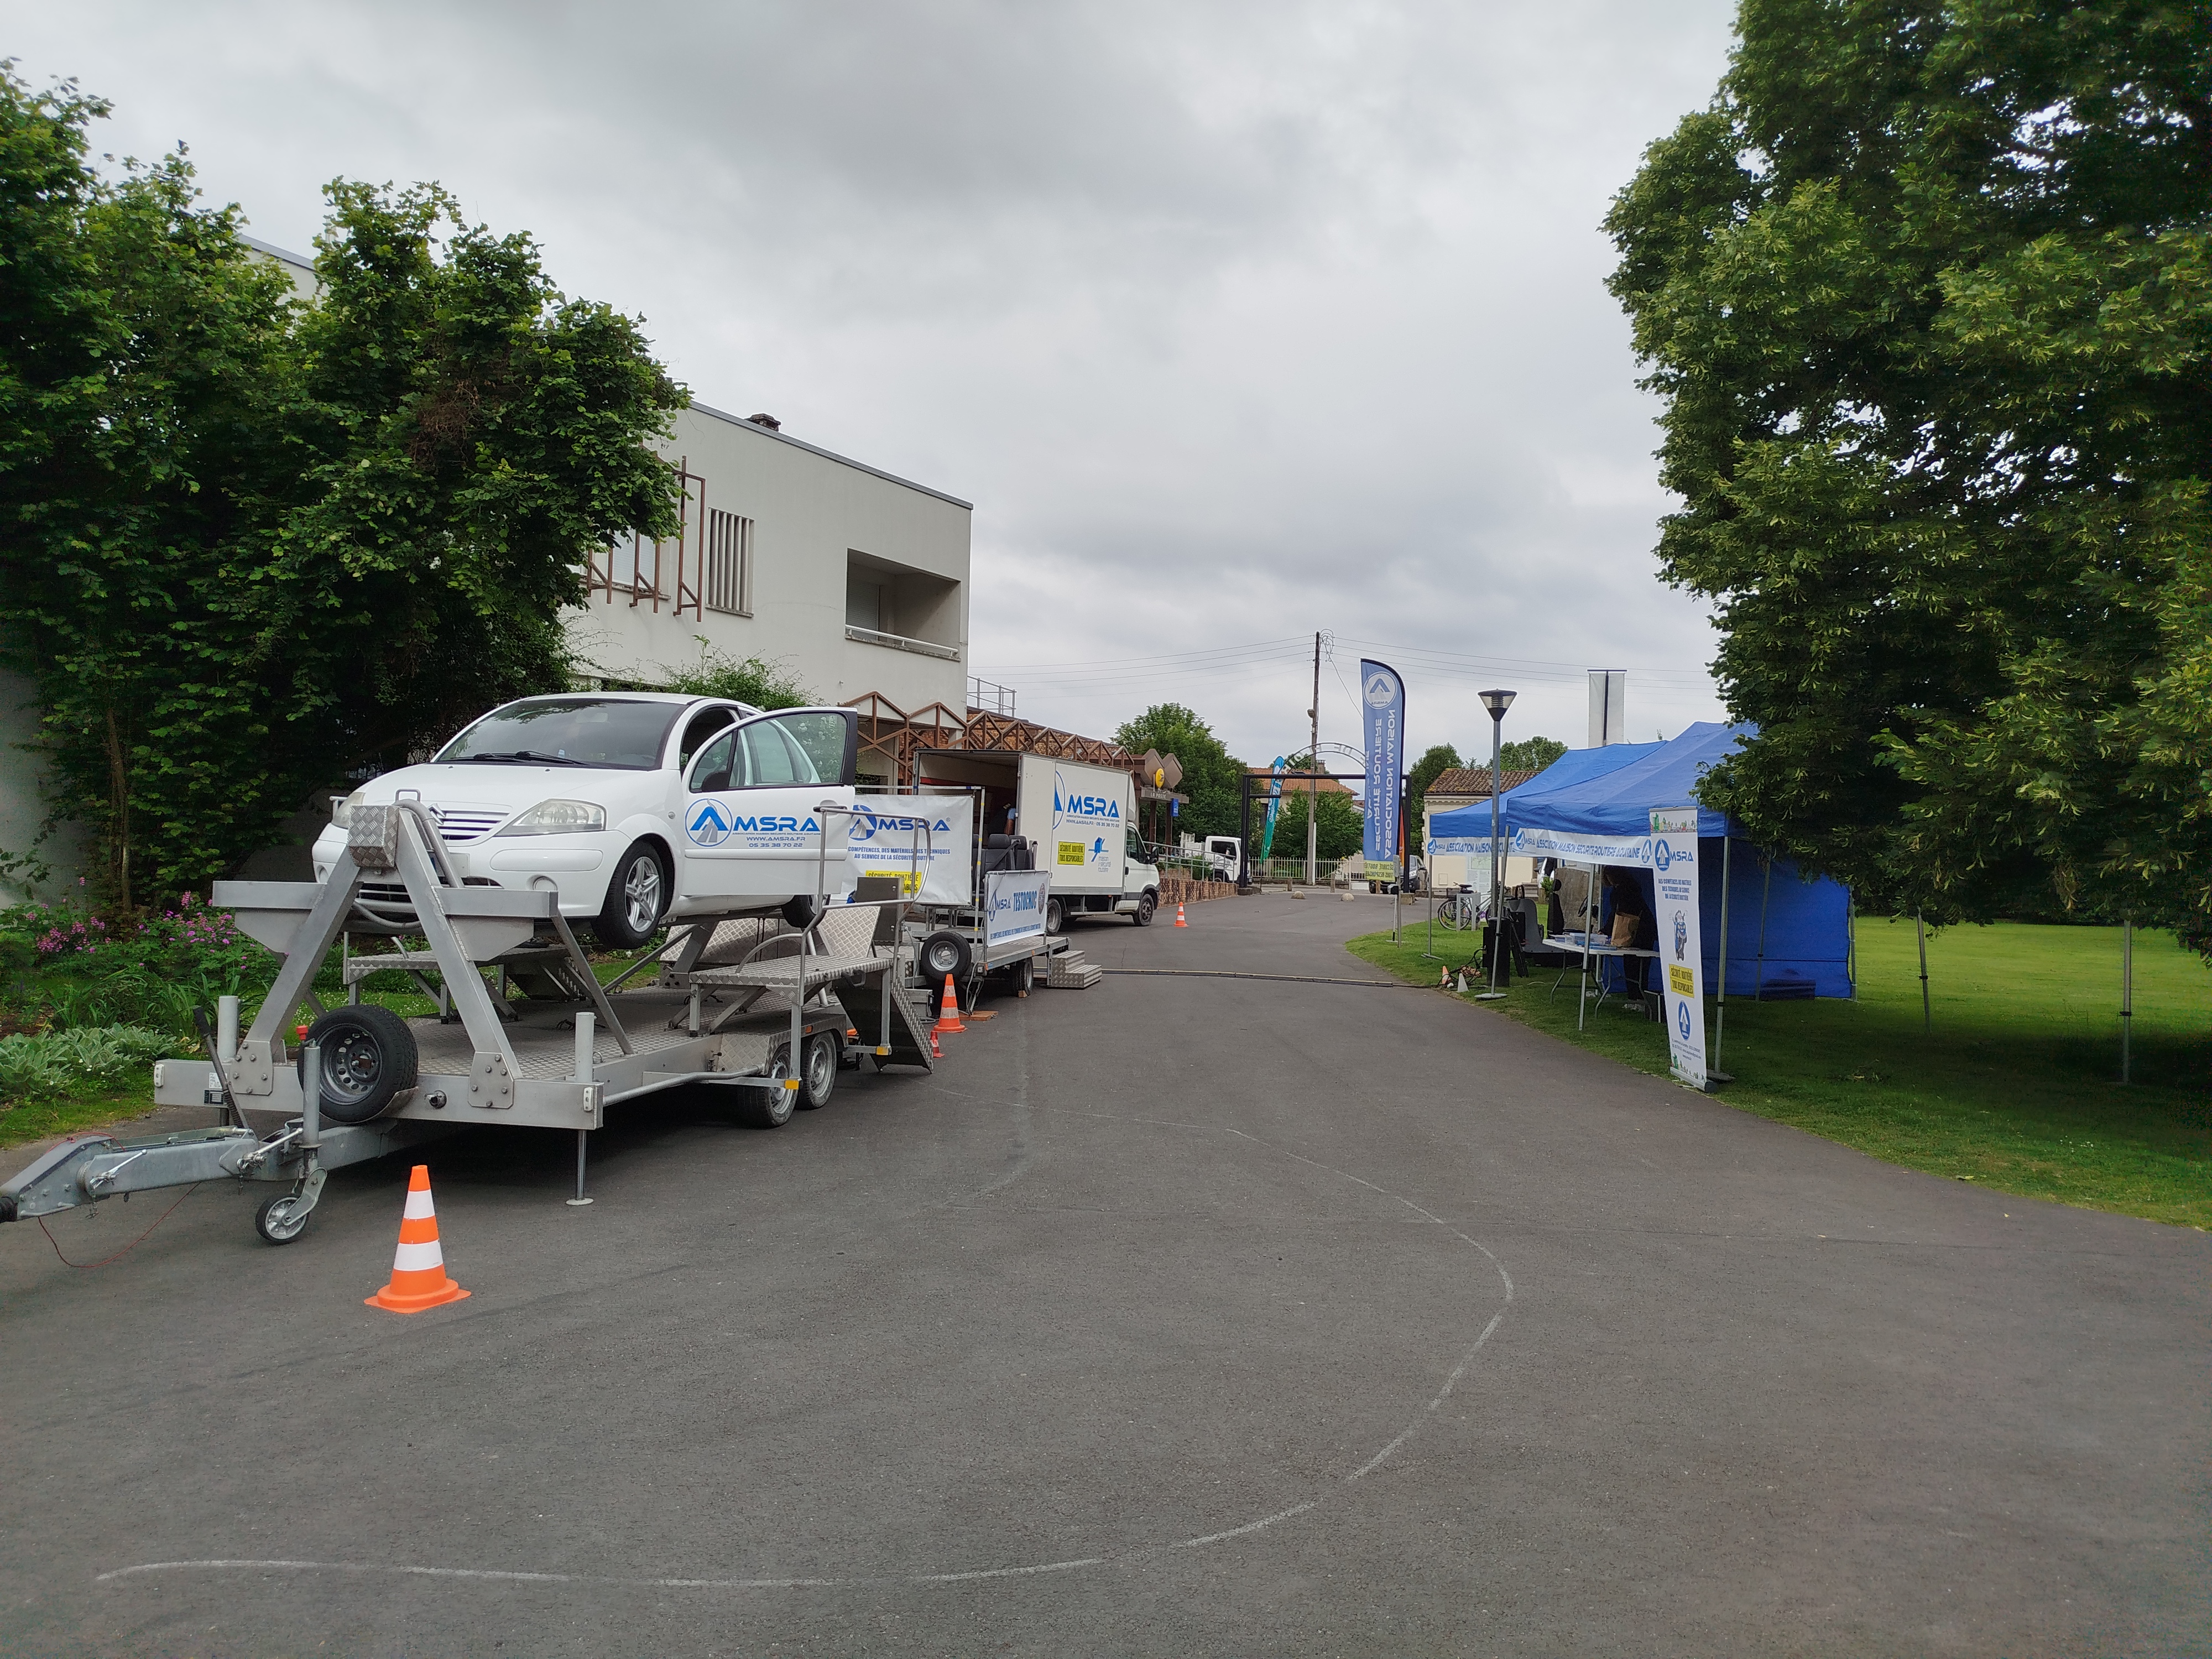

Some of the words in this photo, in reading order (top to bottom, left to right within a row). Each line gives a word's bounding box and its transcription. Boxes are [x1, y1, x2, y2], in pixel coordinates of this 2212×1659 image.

[1446, 842, 1474, 853] ASSCIATION
[1474, 843, 1492, 853] MAISON
[1558, 842, 1576, 853] MAISON
[894, 873, 919, 881] ROUTIÈE
